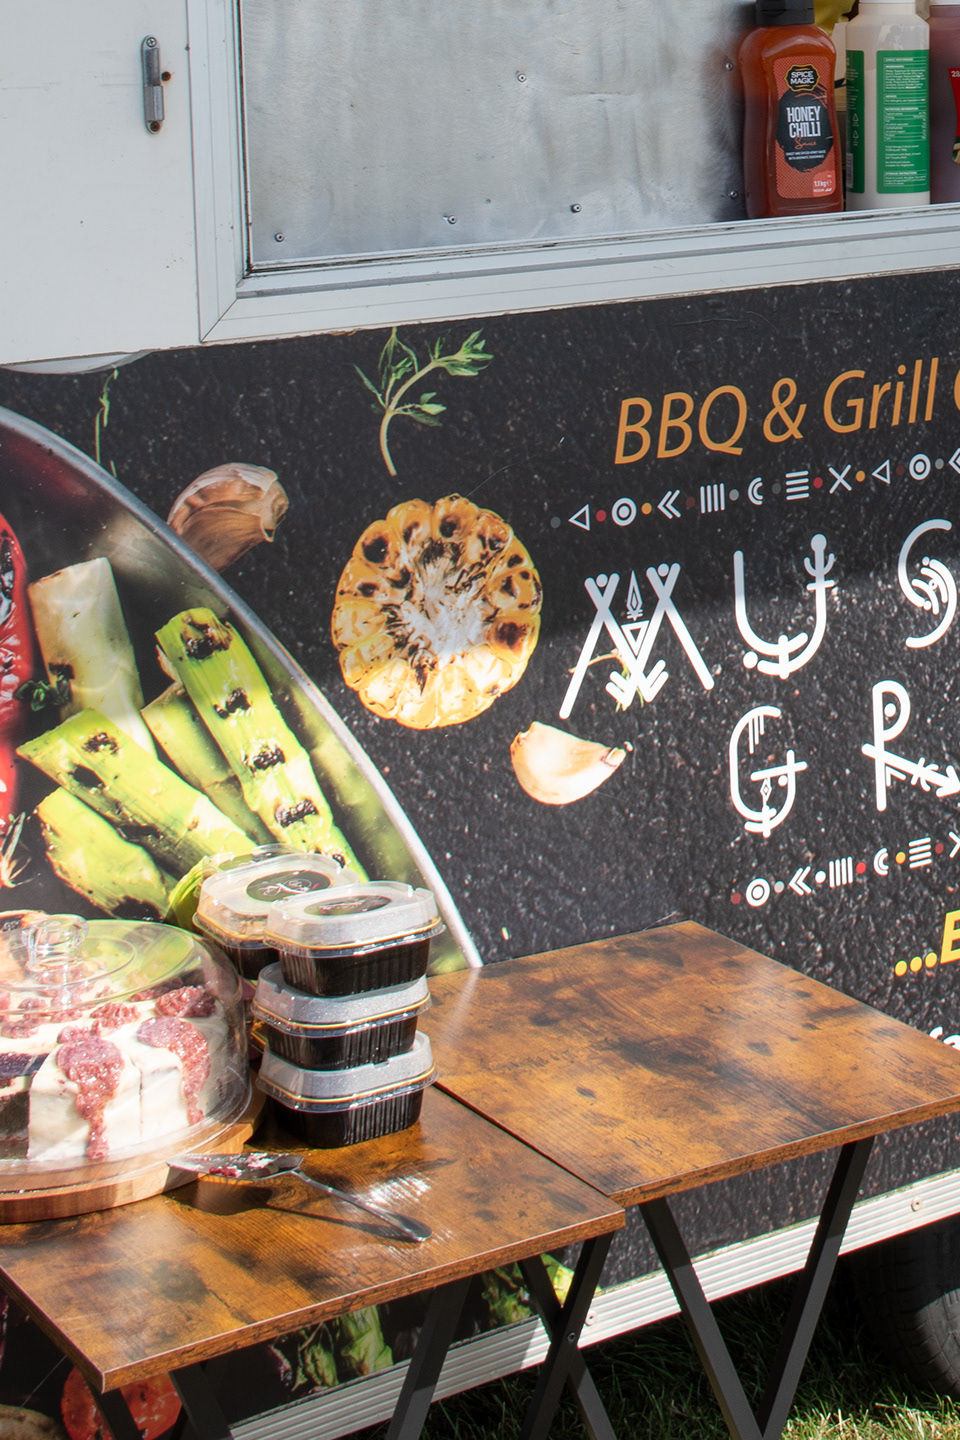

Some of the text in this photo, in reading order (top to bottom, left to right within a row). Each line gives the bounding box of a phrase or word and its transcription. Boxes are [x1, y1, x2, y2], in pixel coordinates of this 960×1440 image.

[791, 71, 814, 79] SPICE
[786, 105, 821, 122] HONEY
[789, 121, 821, 138] CHILLI
[614, 384, 748, 465] BBQ
[762, 378, 807, 444] &
[822, 357, 939, 434] Grill
